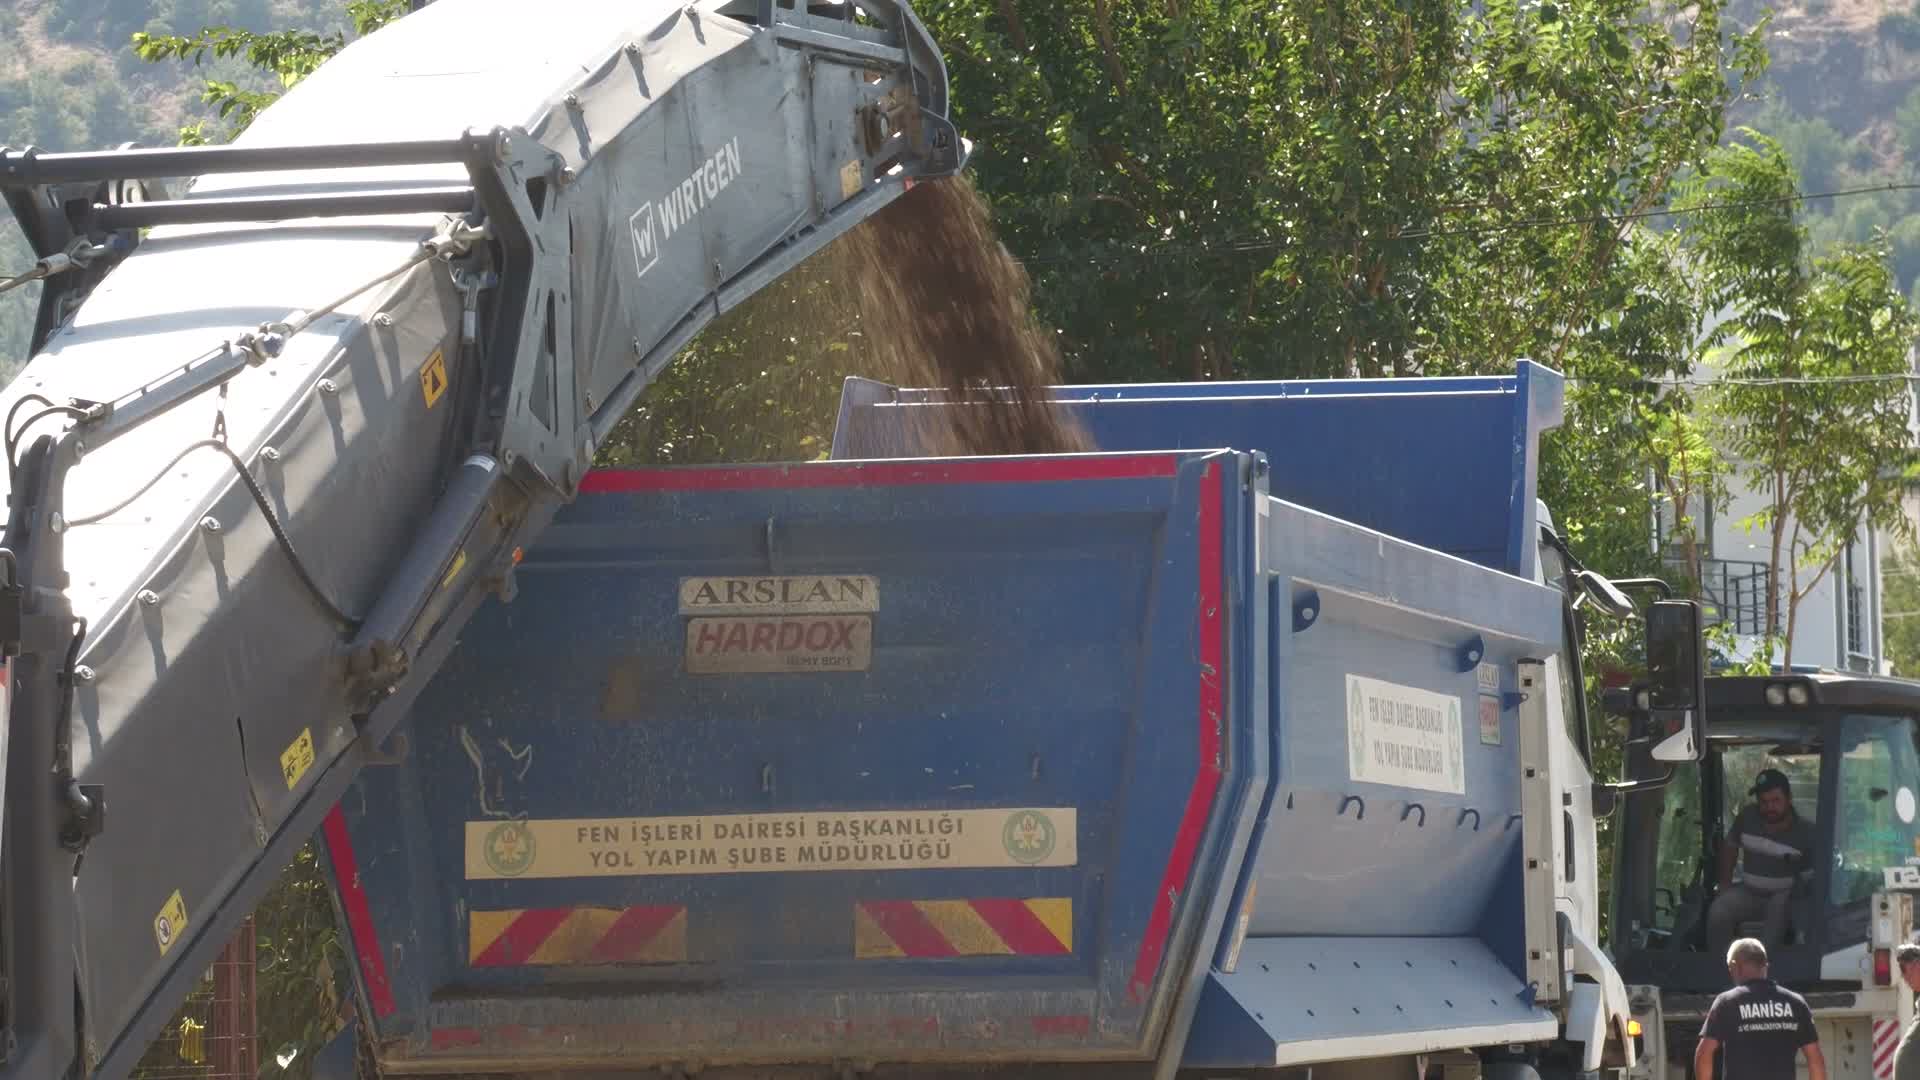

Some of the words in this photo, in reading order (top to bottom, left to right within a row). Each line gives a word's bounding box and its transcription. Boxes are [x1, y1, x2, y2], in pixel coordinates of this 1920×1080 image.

[658, 136, 741, 240] WIRTGEN
[691, 578, 868, 604] ARSLAN
[695, 619, 858, 653] HARDOX
[577, 826, 619, 843] FEN
[632, 819, 702, 846] İŞLERİ
[714, 816, 806, 840] DAİRESİ
[817, 813, 964, 841] BAŞKANLIĞI
[590, 851, 633, 868] YOL
[646, 848, 717, 867] YAPIM
[728, 847, 786, 868] ŞUBE
[798, 838, 951, 863] MÜDÜRLÜĞÜ
[1739, 1000, 1793, 1020] MANİSA
